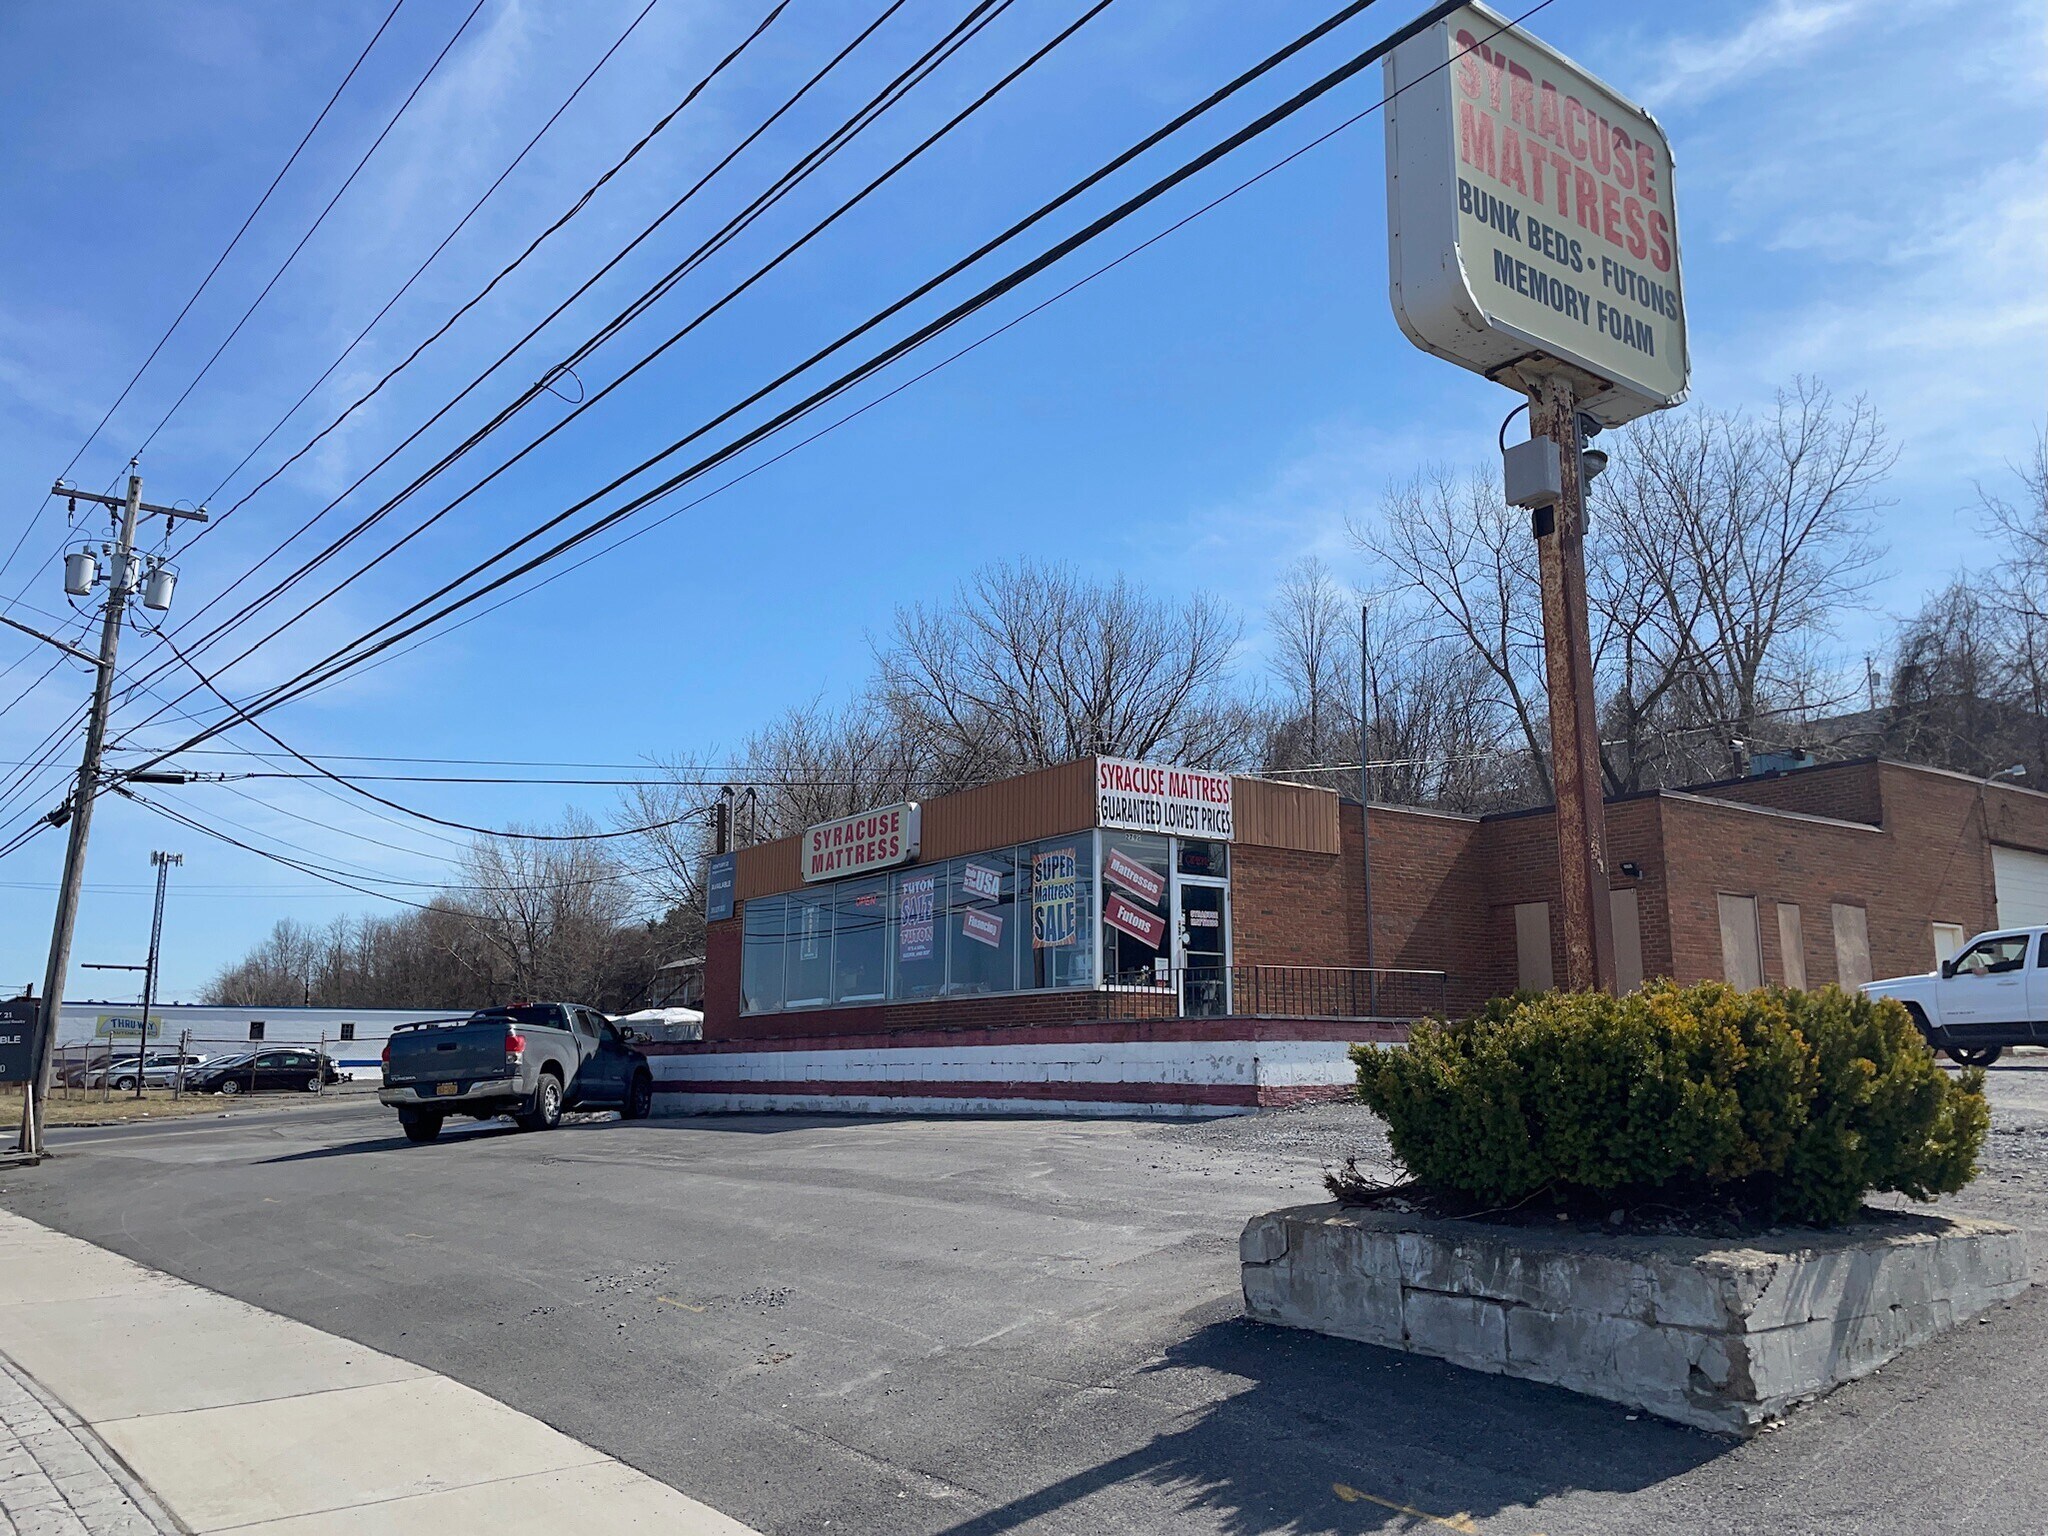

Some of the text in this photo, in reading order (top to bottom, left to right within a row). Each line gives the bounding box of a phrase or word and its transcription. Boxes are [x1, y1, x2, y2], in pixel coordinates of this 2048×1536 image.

[1456, 29, 1656, 204] SYRACUSE
[1459, 99, 1671, 273] MATTRESS
[1458, 177, 1678, 322] BUNK BEDS FUTONS
[1493, 248, 1655, 357] MEMORY FOAM
[1100, 763, 1229, 804] SYRACUSE MATTRESS
[813, 811, 900, 852] SYRACUSE
[1100, 795, 1231, 834] GUARANTEED LOWEST PRICES
[811, 835, 899, 875] MATTRESS
[1034, 855, 1074, 882] SUPER
[902, 878, 934, 895] FUTON
[976, 870, 1000, 898] USA
[1034, 882, 1074, 903] Mattress
[1110, 858, 1159, 894] Mattresses
[901, 893, 934, 926] SALE
[968, 915, 997, 936] Financing
[1034, 901, 1074, 941] SALE
[1116, 904, 1151, 933] Futons
[900, 926, 933, 944] FUTON
